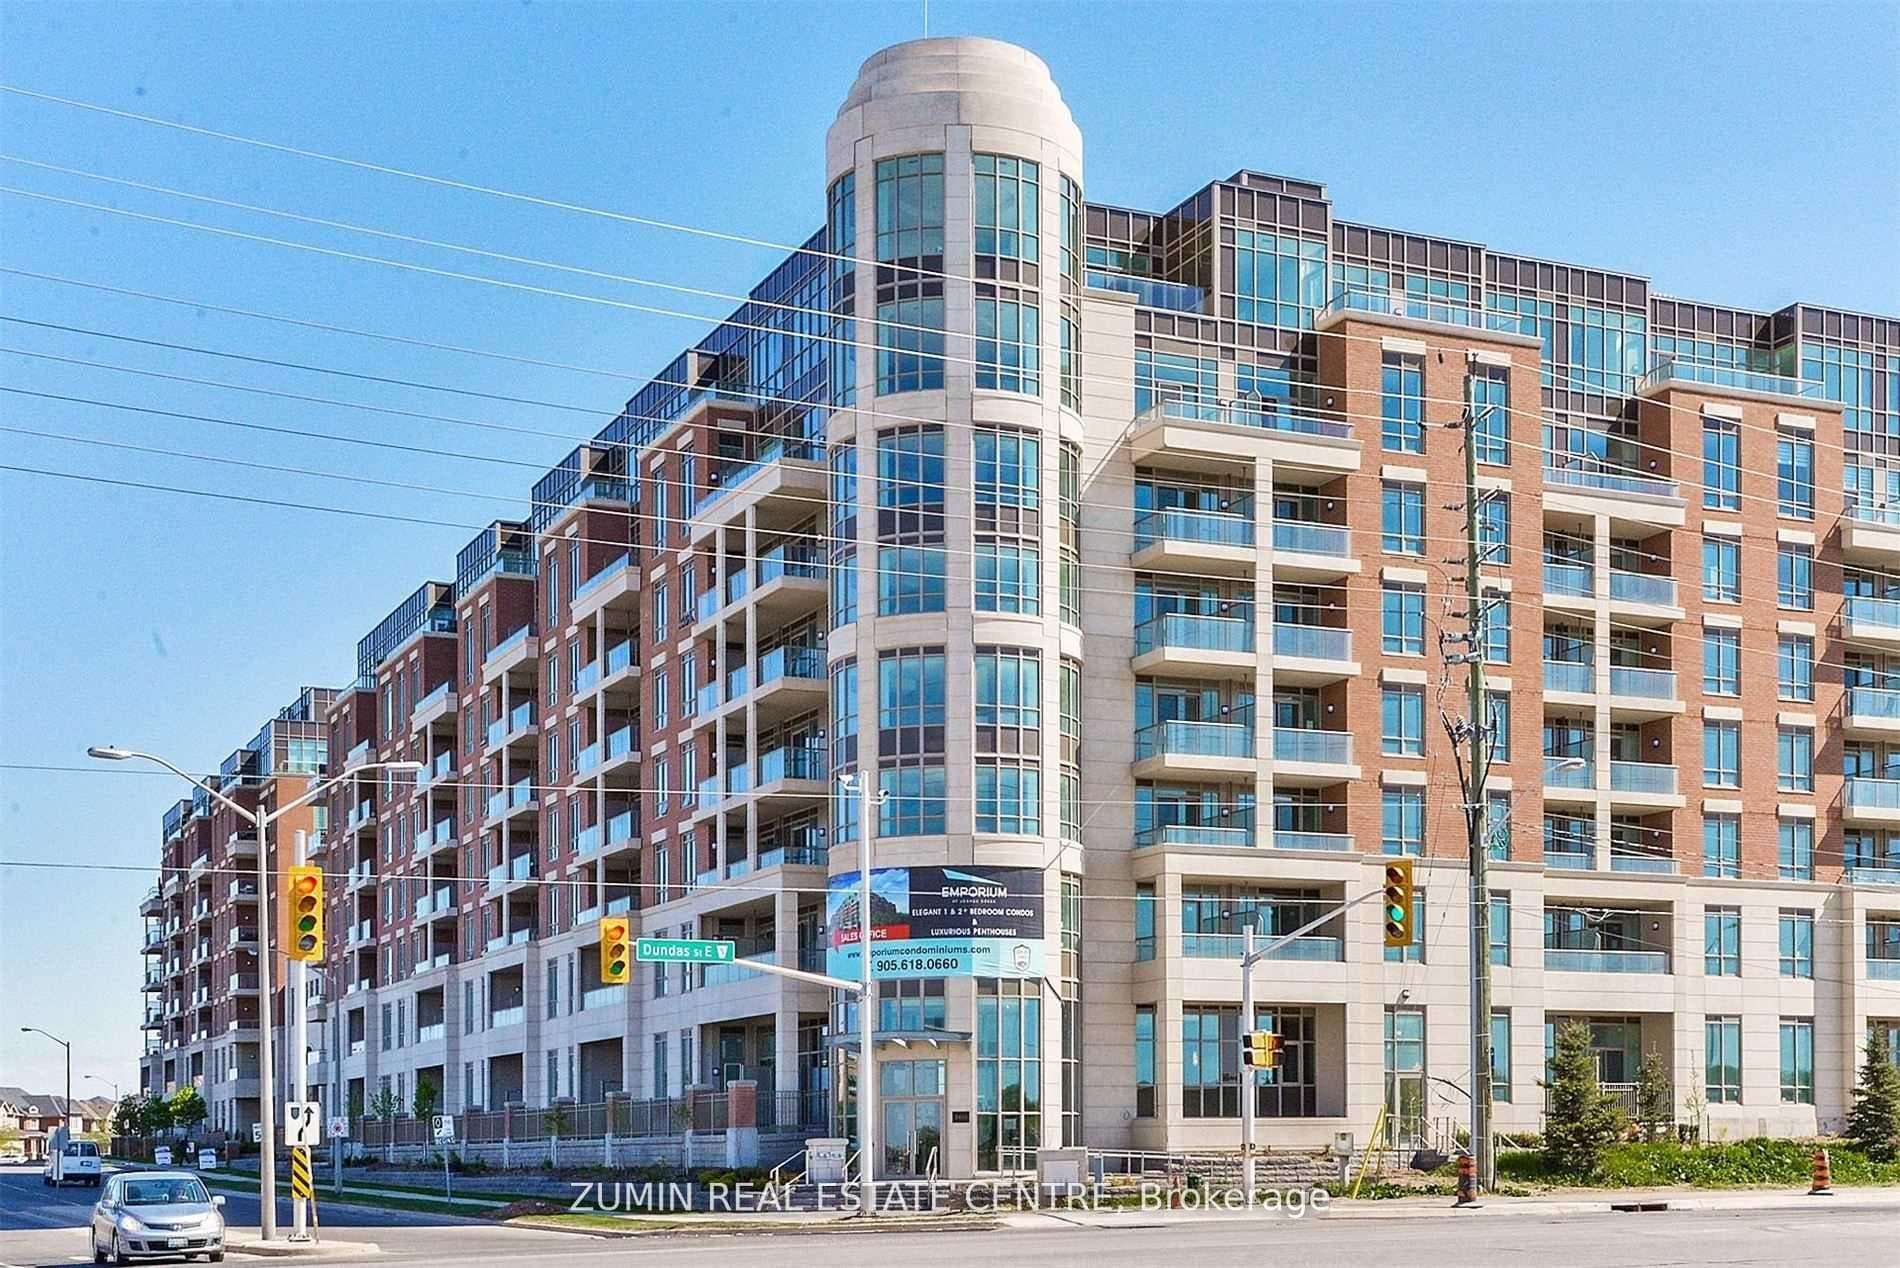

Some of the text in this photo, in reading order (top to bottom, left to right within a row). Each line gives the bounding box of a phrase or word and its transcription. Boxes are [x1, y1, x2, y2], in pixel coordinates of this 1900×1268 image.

[941, 887, 1008, 898] EMPORIUM
[911, 908, 942, 917] ELEGANT
[969, 908, 1004, 917] BEDROOM
[1005, 908, 1035, 917] CONDOS
[840, 931, 858, 942] SALES
[930, 927, 1017, 936] LUXURIOUS PENTHOUSES
[642, 943, 690, 957] Dundas
[705, 945, 712, 957] E
[877, 958, 959, 972] 905.618.0660
